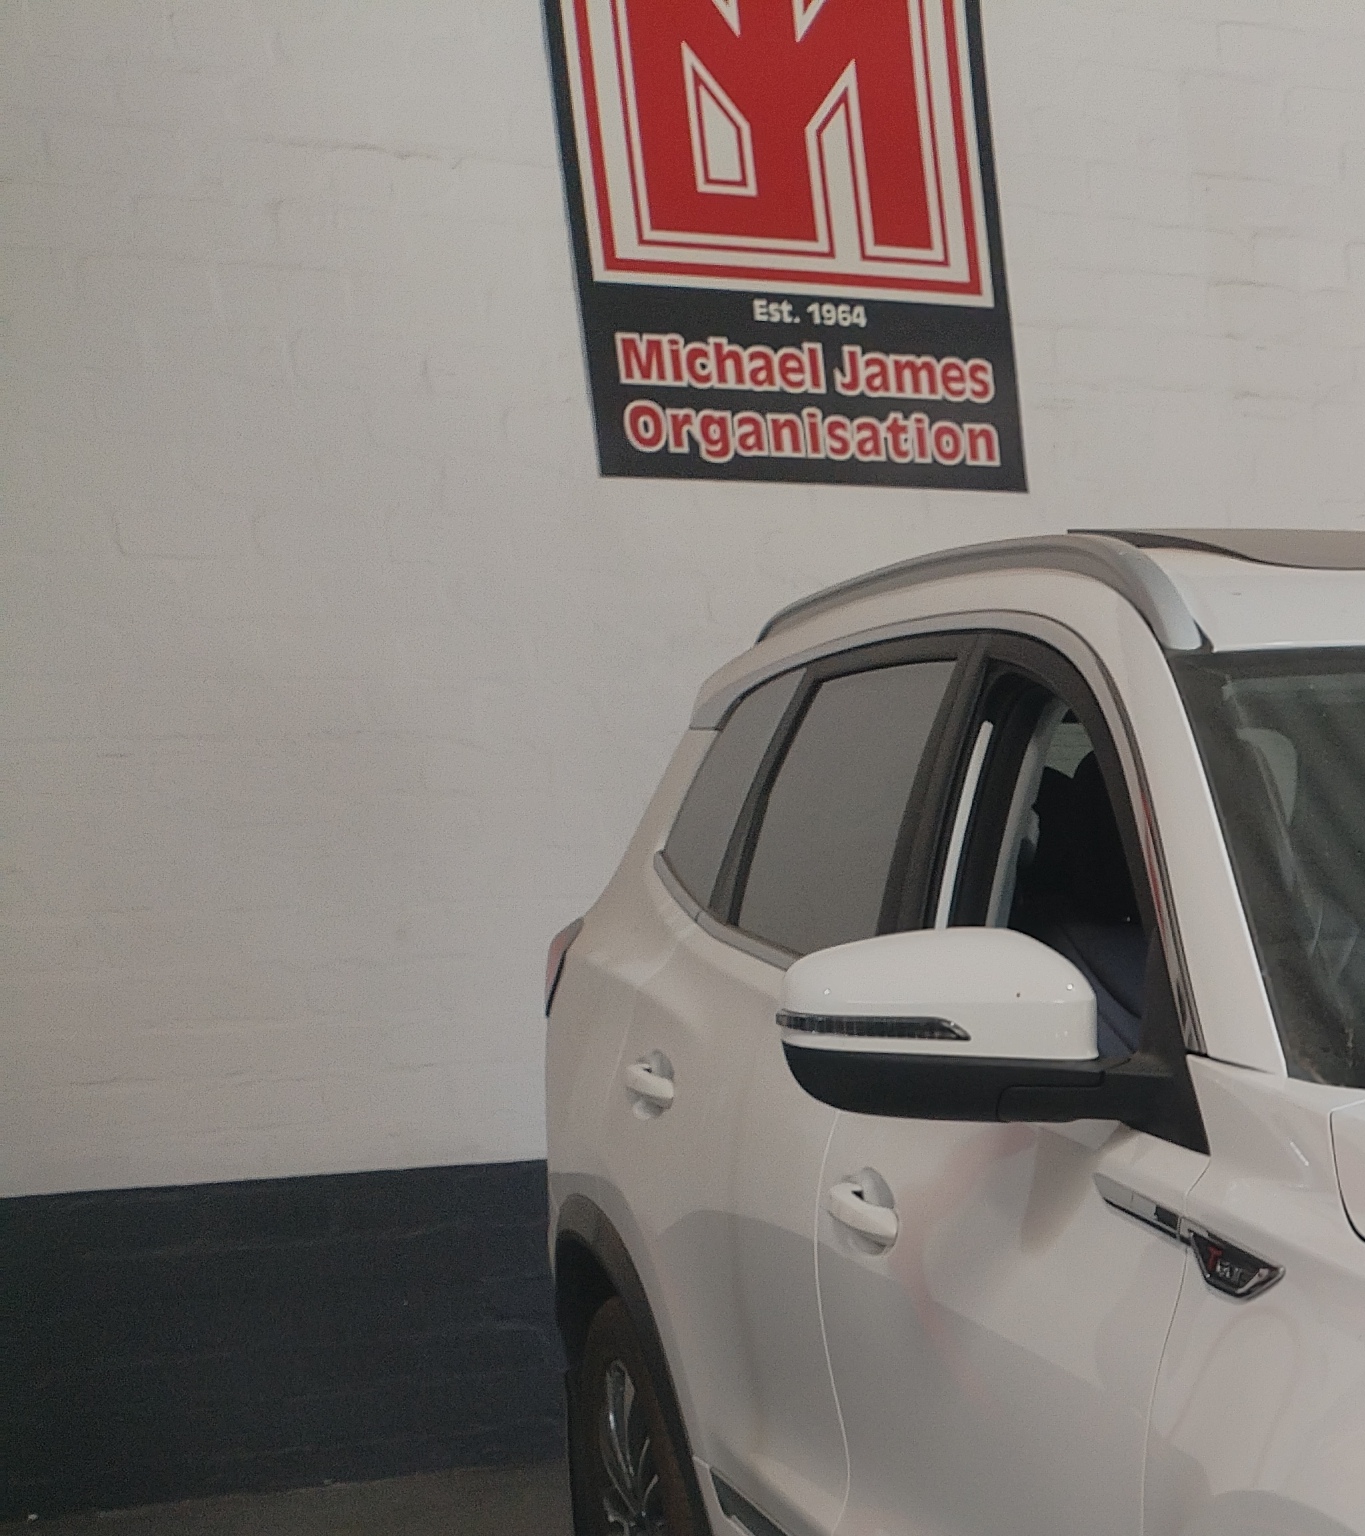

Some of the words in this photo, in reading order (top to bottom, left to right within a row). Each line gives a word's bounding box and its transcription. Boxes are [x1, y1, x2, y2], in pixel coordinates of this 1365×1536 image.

[753, 299, 799, 324] Est.
[807, 302, 867, 328] 1964
[615, 332, 825, 393] Michael
[834, 346, 994, 402] James
[624, 398, 1001, 467] Organisation
